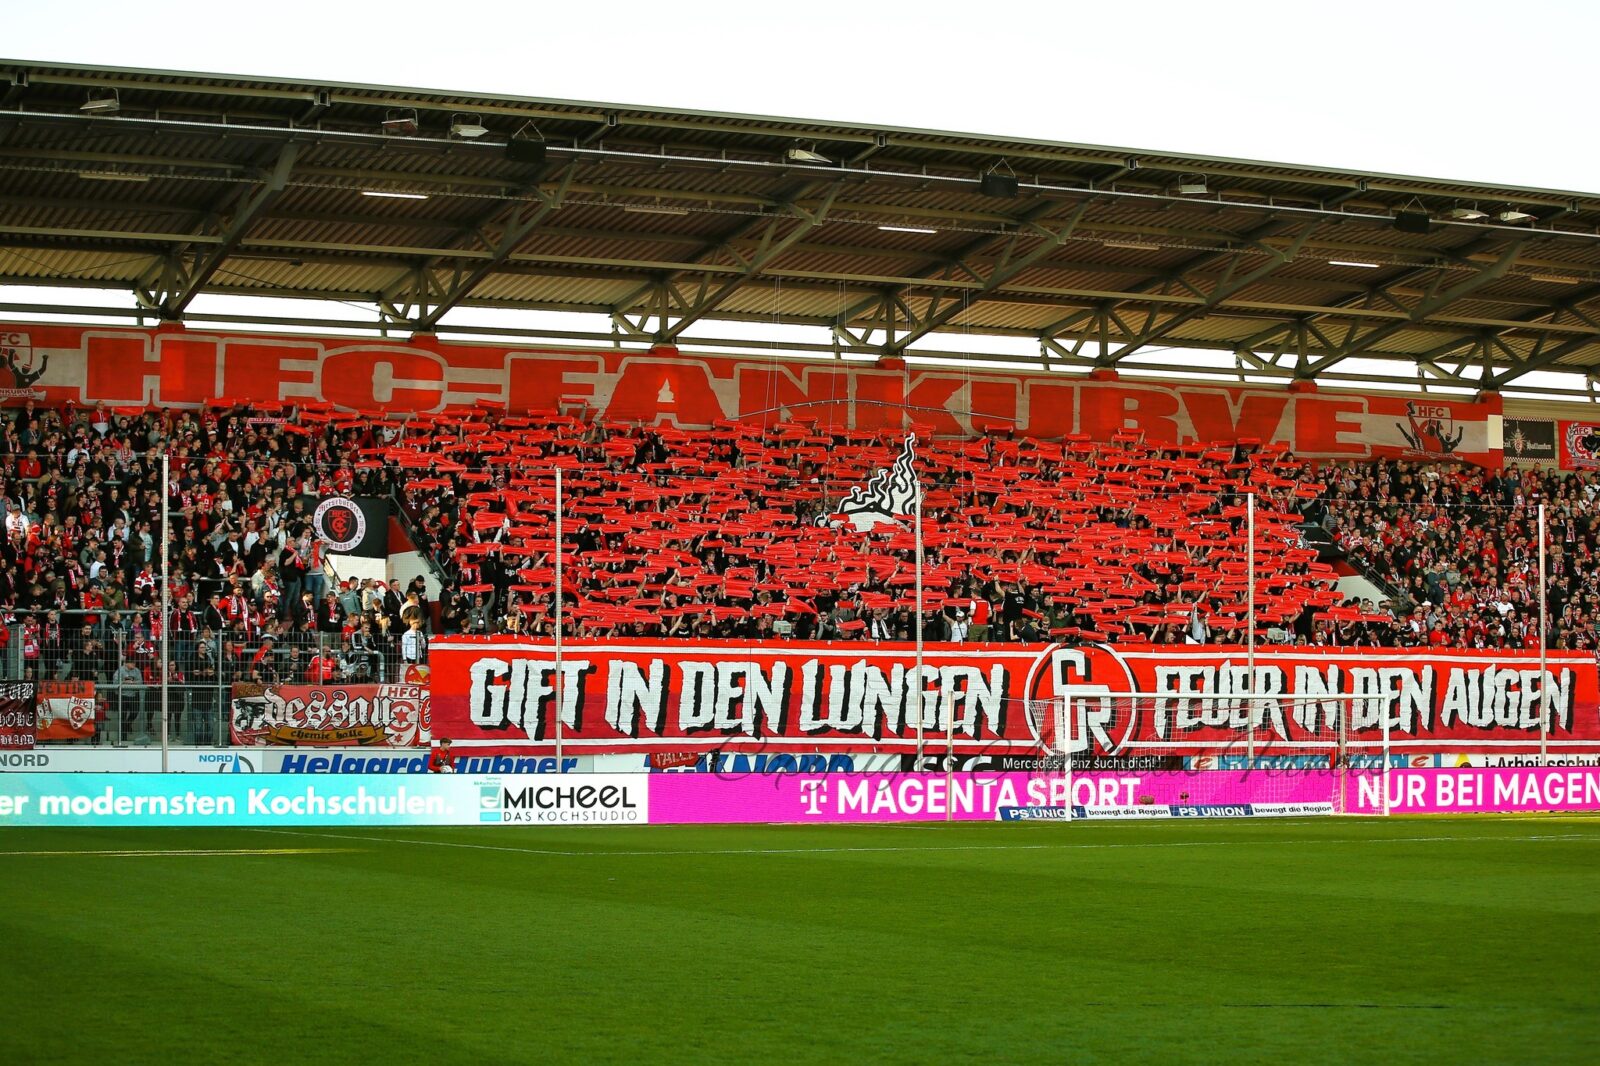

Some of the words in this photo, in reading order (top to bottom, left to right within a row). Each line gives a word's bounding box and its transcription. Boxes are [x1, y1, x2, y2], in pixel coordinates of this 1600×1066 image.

[1418, 406, 1445, 417] HFC
[387, 686, 418, 698] HFC
[468, 656, 595, 741] GIFT
[605, 657, 671, 739] IN
[678, 658, 793, 741] DEN
[799, 658, 1011, 742] LUNGEN
[1153, 659, 1291, 742] FEUER
[1292, 663, 1345, 734] IN
[1348, 664, 1433, 735] DEN
[1441, 663, 1576, 736] AUGEN
[198, 754, 233, 764] NORD
[1002, 757, 1090, 769] Mercedes-enz
[1093, 757, 1129, 769] sucht
[1132, 757, 1156, 769] dich!
[837, 778, 1019, 814] MAGENTA
[1025, 777, 1142, 809] SPORT
[1357, 774, 1427, 808] NUR
[1436, 773, 1484, 807] BEI
[1493, 771, 1600, 807] MAGEN
[39, 786, 236, 816] modernsten
[247, 785, 456, 816] Kochschulen.
[503, 811, 533, 822] DAS
[537, 810, 638, 822] KOCHSTUDIO
[1009, 808, 1030, 819] PS
[1088, 808, 1121, 817] bewegt
[1123, 807, 1137, 816] die
[1138, 807, 1170, 817] Region
[1178, 806, 1199, 817] PS
[1200, 805, 1246, 817] UNION
[1254, 805, 1287, 815] bewegt
[1288, 805, 1301, 813] die
[1303, 804, 1332, 814] Region
